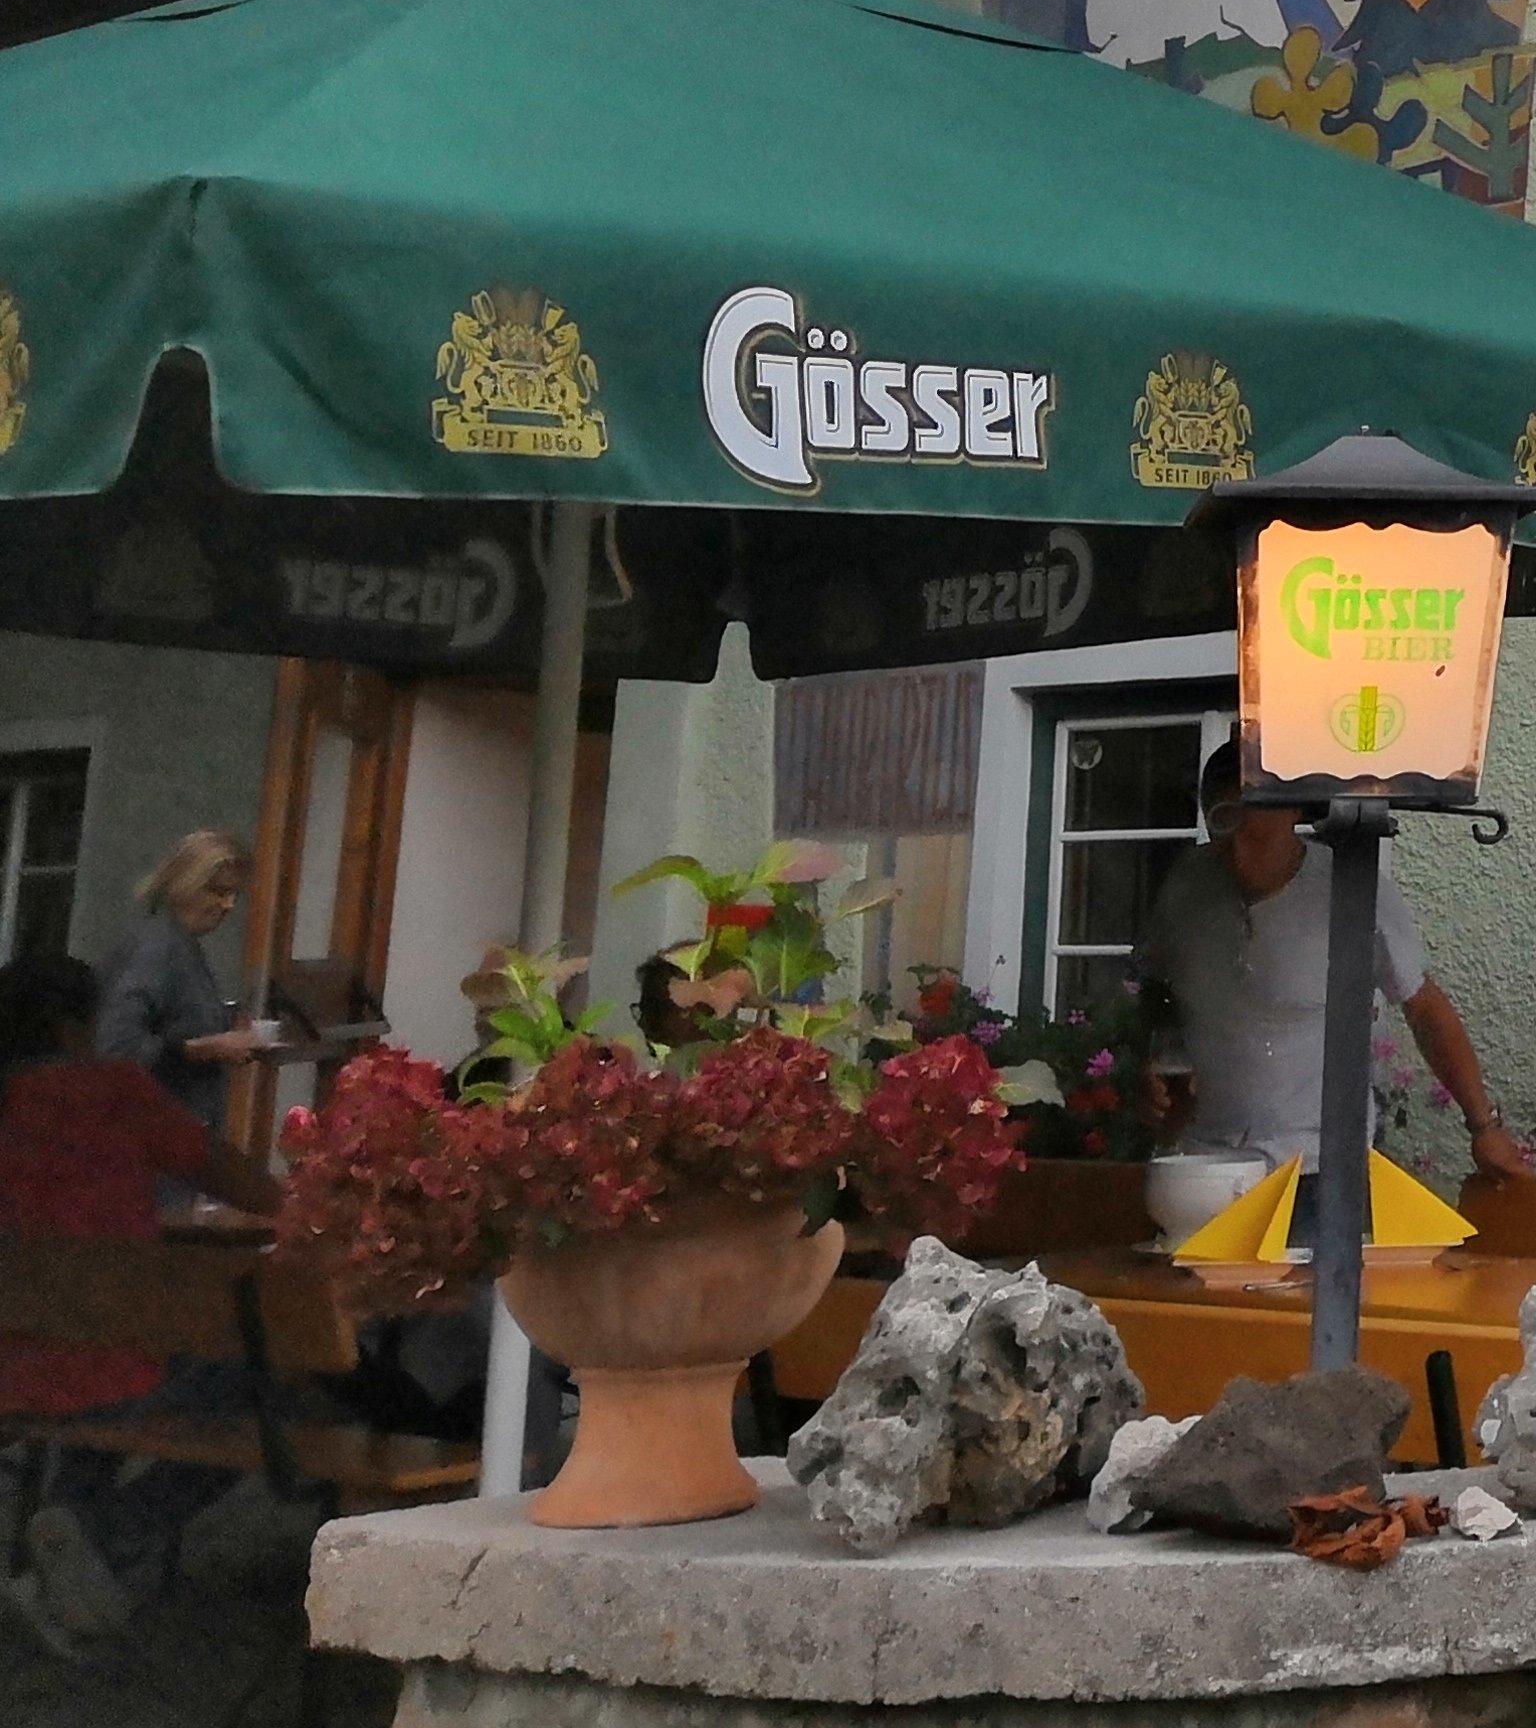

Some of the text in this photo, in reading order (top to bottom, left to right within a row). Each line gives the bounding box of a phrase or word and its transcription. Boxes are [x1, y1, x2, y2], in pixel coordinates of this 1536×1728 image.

[703, 286, 1048, 485] Gösser
[467, 429, 583, 452] SEIT 1860
[1154, 467, 1190, 484] SEIT
[1280, 555, 1466, 661] Gösser
[1362, 636, 1455, 662] BIER
